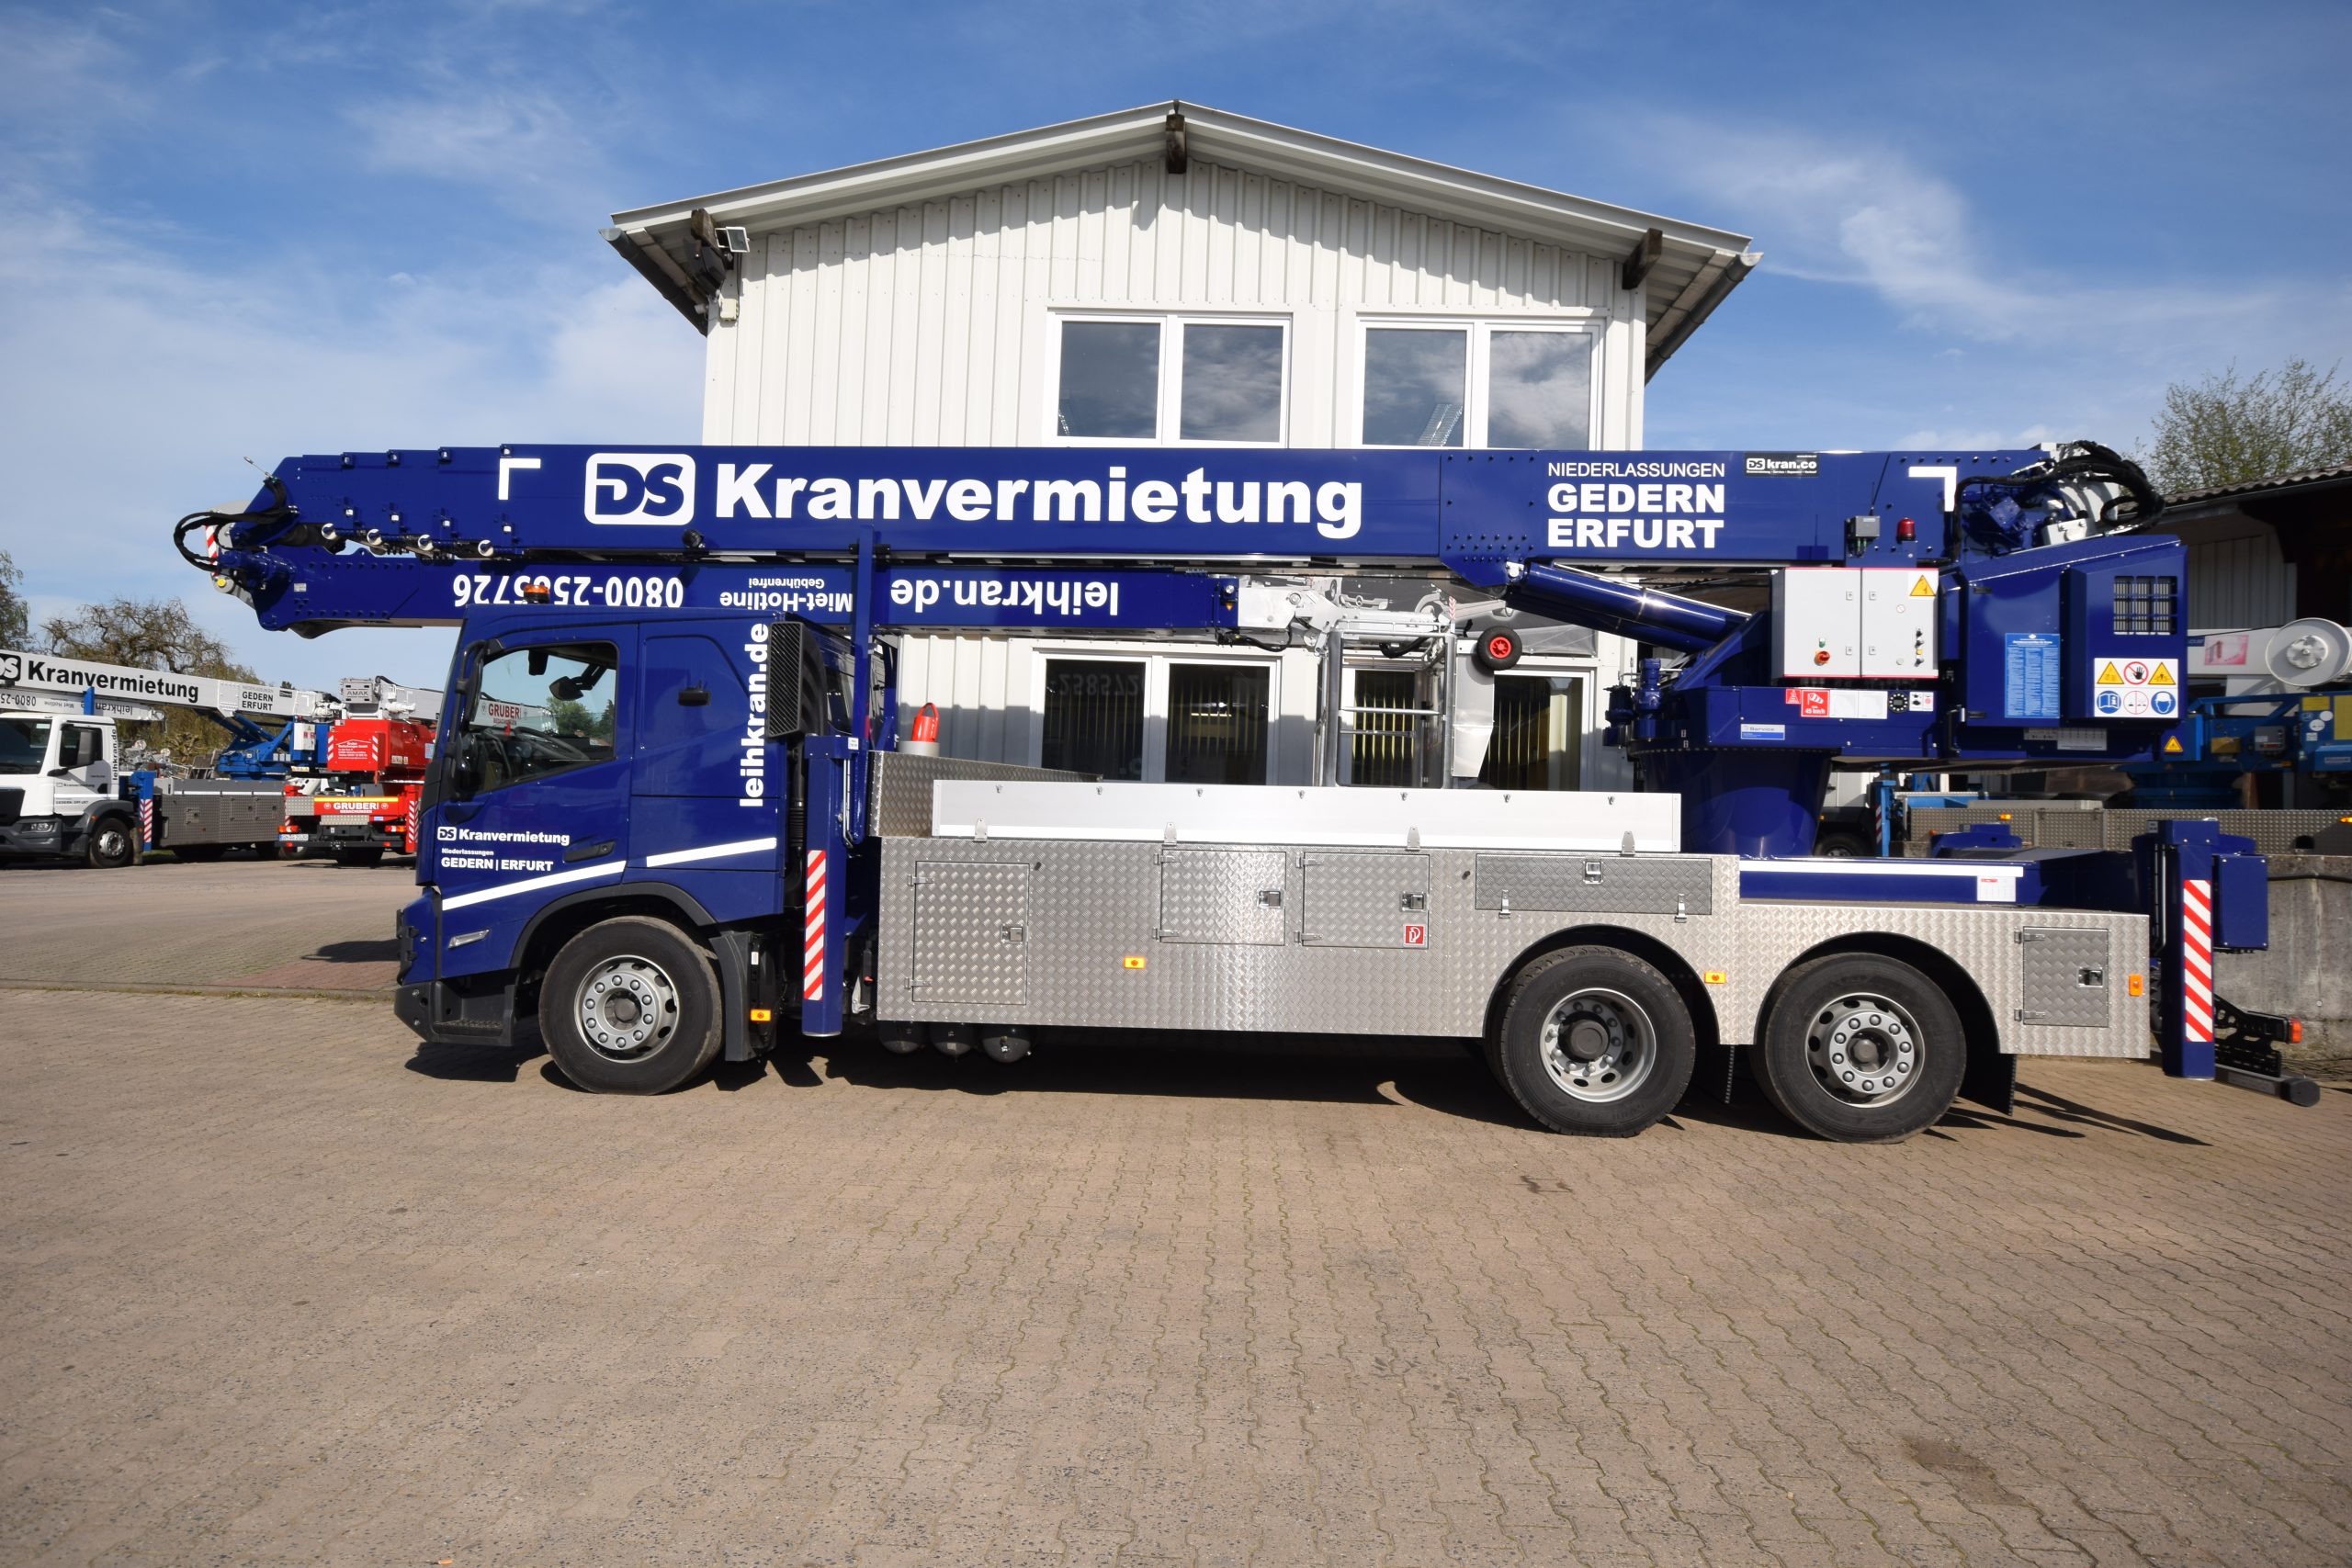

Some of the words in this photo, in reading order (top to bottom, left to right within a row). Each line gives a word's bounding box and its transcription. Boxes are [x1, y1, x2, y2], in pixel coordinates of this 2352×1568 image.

[1548, 462, 1725, 478] NIEDERLASSUNGEN
[1767, 458, 1817, 469] kran.co
[716, 463, 1363, 539] Kranvermietung
[1547, 483, 1725, 513] GEDERN
[1547, 518, 1724, 549] ERFURT
[452, 574, 684, 608] 0800-255726
[748, 577, 825, 590] Gebührenfrei
[719, 591, 854, 613] Miet-Hotline
[890, 579, 1119, 616] leihkran.de
[28, 660, 199, 704] Kranvermietung
[242, 691, 274, 703] GEDERN
[242, 700, 274, 711] ERFURT
[488, 703, 520, 719] GRUBER
[739, 623, 769, 807] leihkran.de
[333, 802, 377, 810] GRUBER
[458, 829, 571, 846] Kranvermietung
[441, 848, 494, 856] Niederlassungen
[441, 857, 494, 870] GEDERN
[501, 859, 554, 872] ERFURT
